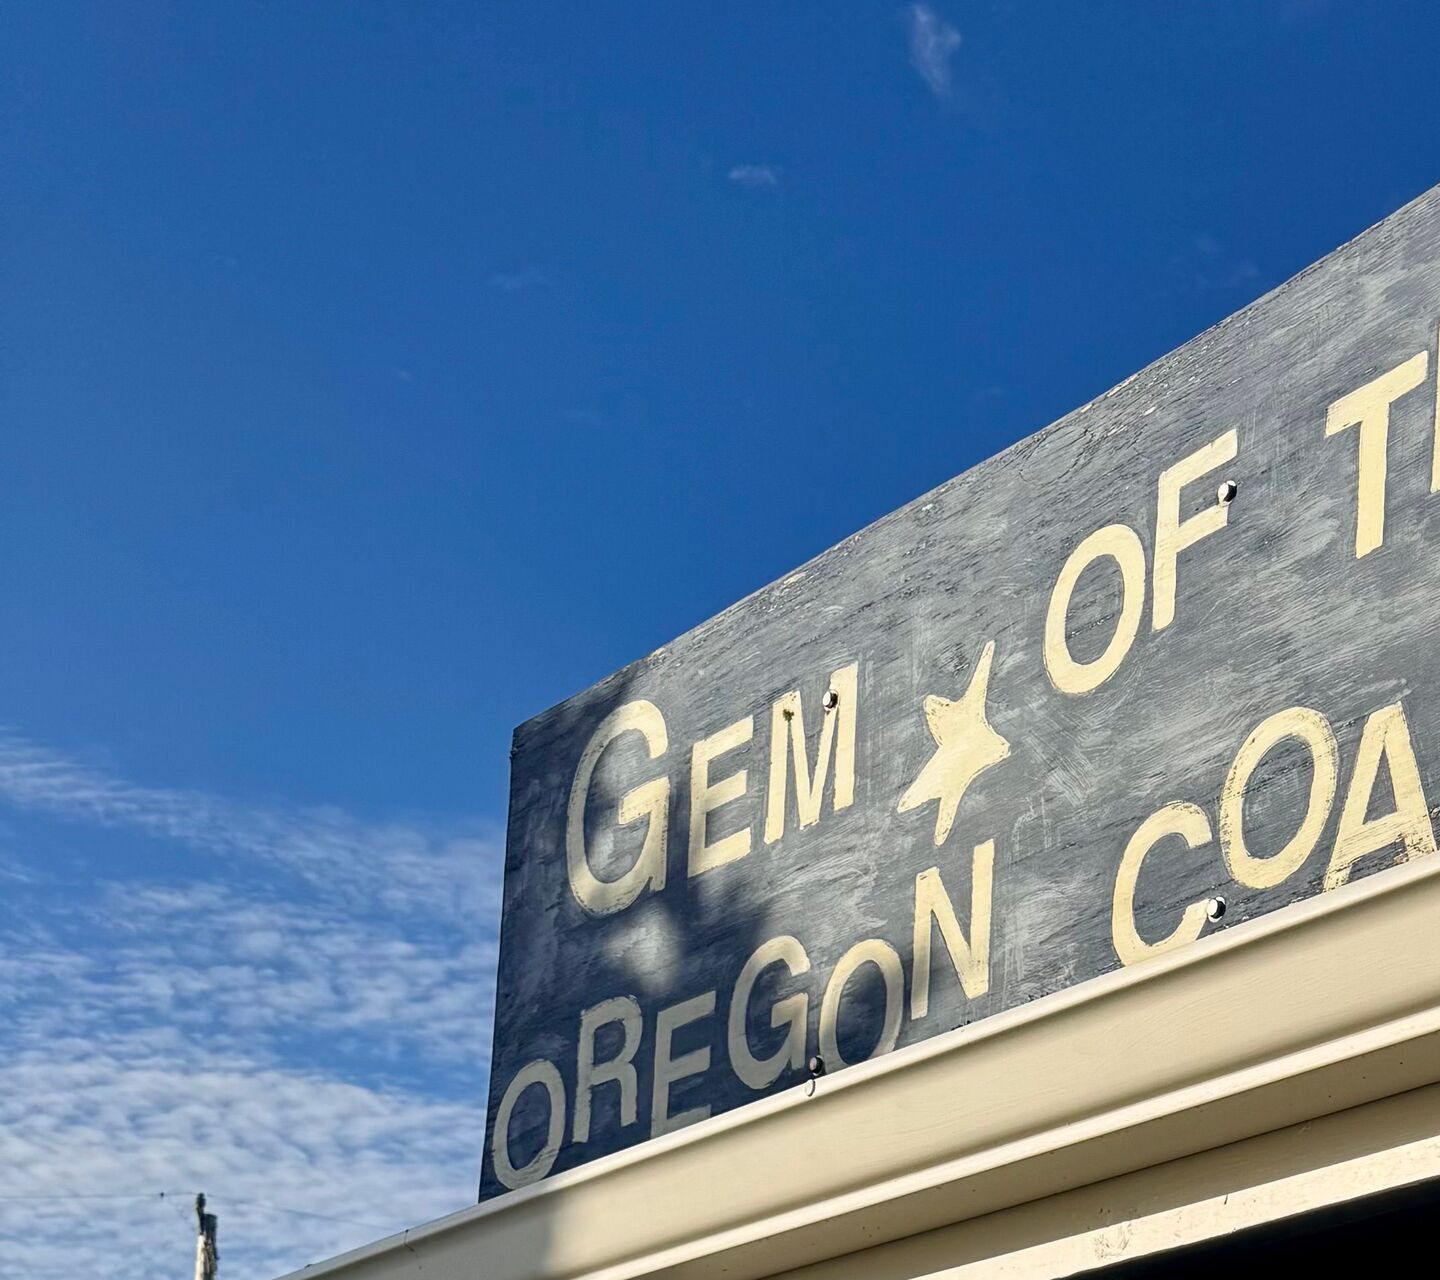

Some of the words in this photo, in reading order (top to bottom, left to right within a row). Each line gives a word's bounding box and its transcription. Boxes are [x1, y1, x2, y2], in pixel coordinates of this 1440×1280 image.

[566, 661, 859, 916] GEM
[1042, 430, 1238, 697] OF
[490, 838, 994, 1190] OREGON
